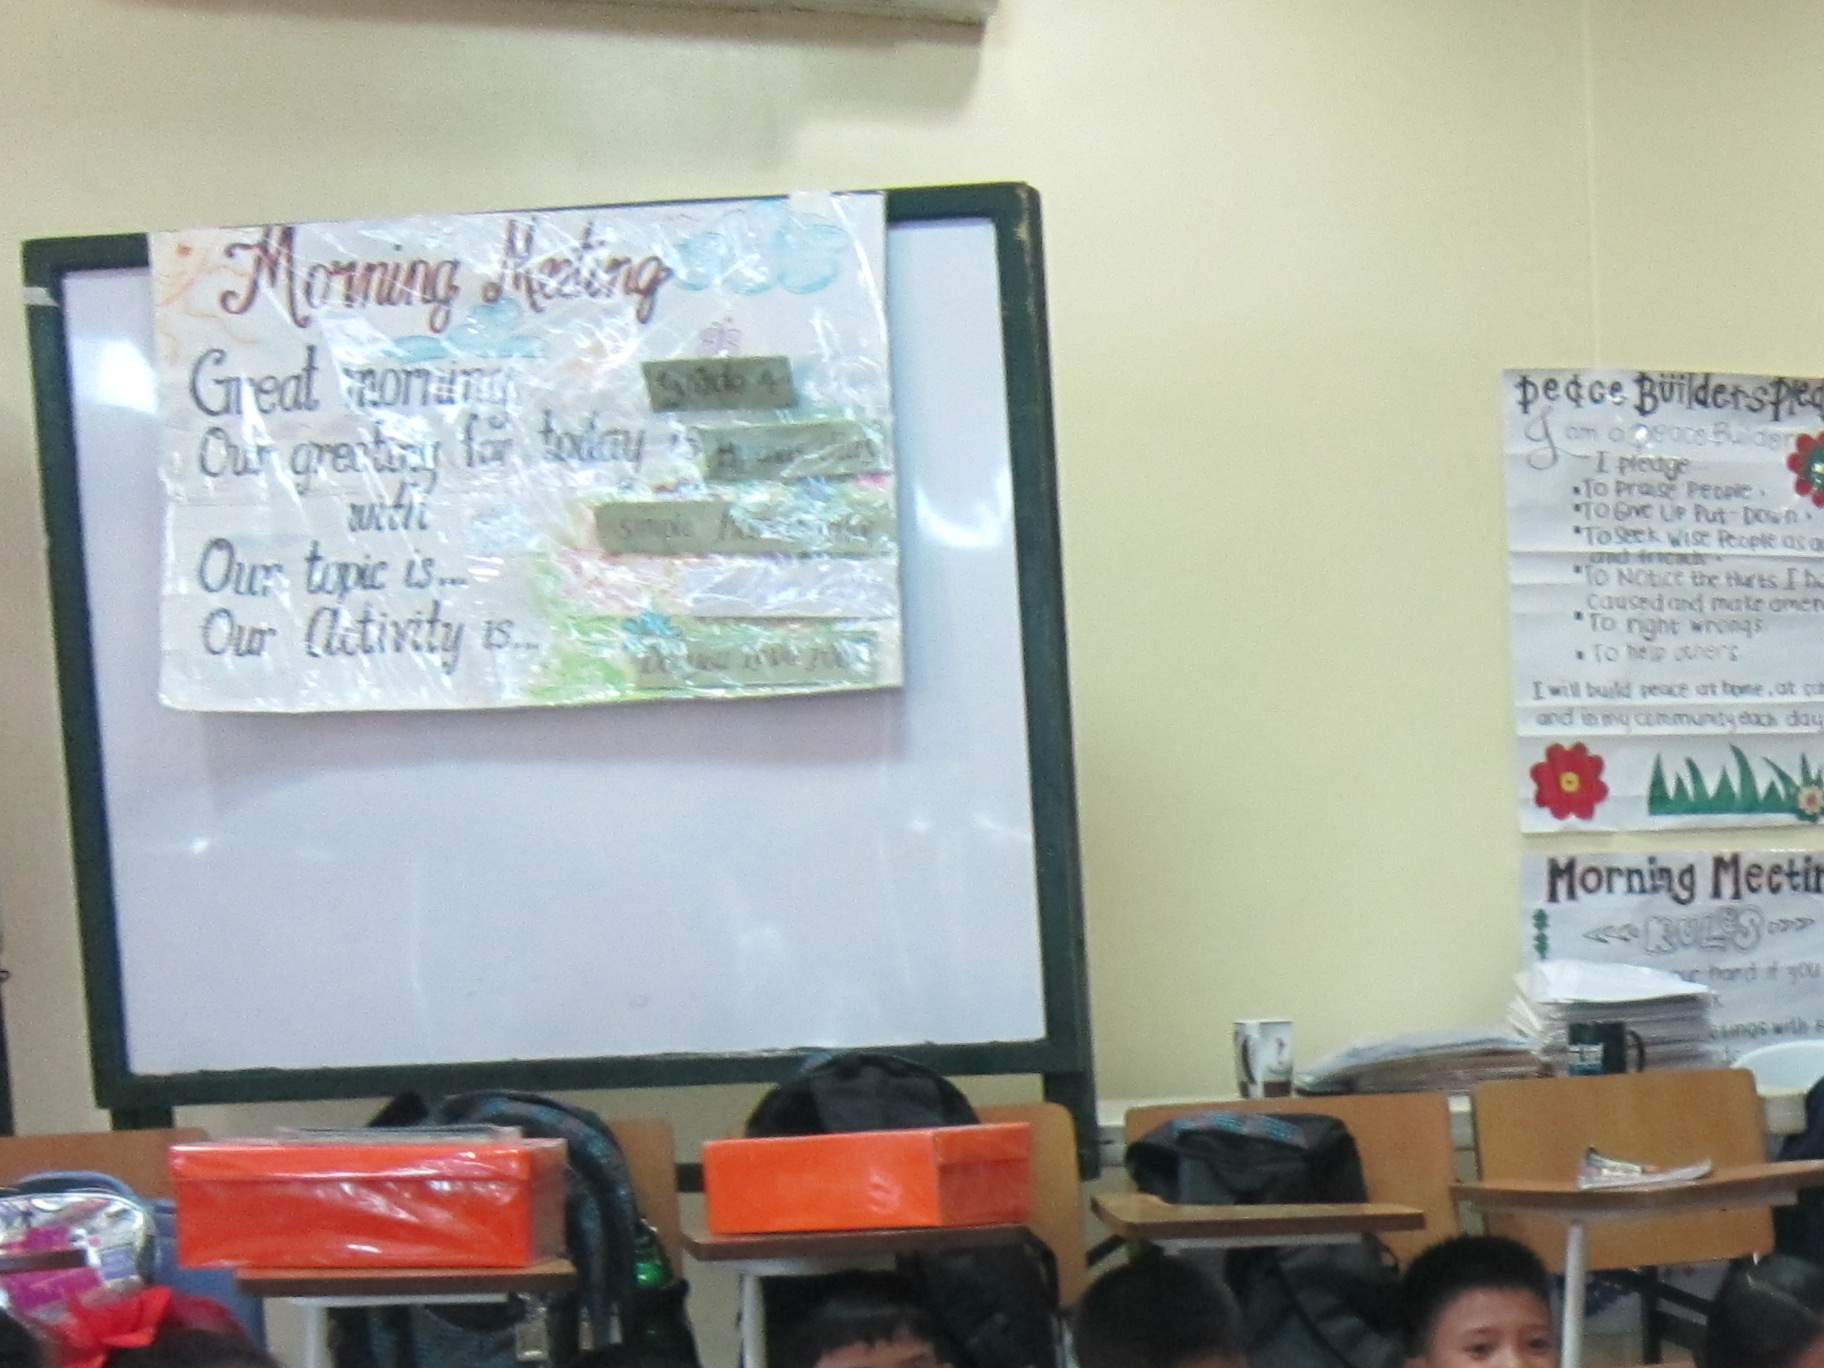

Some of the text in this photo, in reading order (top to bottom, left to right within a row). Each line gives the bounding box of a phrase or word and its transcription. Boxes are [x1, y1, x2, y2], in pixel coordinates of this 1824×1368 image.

[220, 216, 674, 333] Morning Meeting
[189, 344, 320, 417] Great
[199, 426, 273, 478] Our
[291, 420, 442, 495] greeting
[463, 412, 515, 468] for
[540, 409, 645, 475] today
[349, 480, 429, 532] with
[1582, 501, 1610, 521] To
[1583, 479, 1608, 500] To
[199, 537, 284, 597] Our
[305, 540, 389, 602] topic
[203, 606, 277, 657] Our
[306, 600, 465, 675] Activity
[1590, 612, 1616, 632] To
[1594, 643, 1620, 663] To
[1547, 855, 1697, 905] Morning
